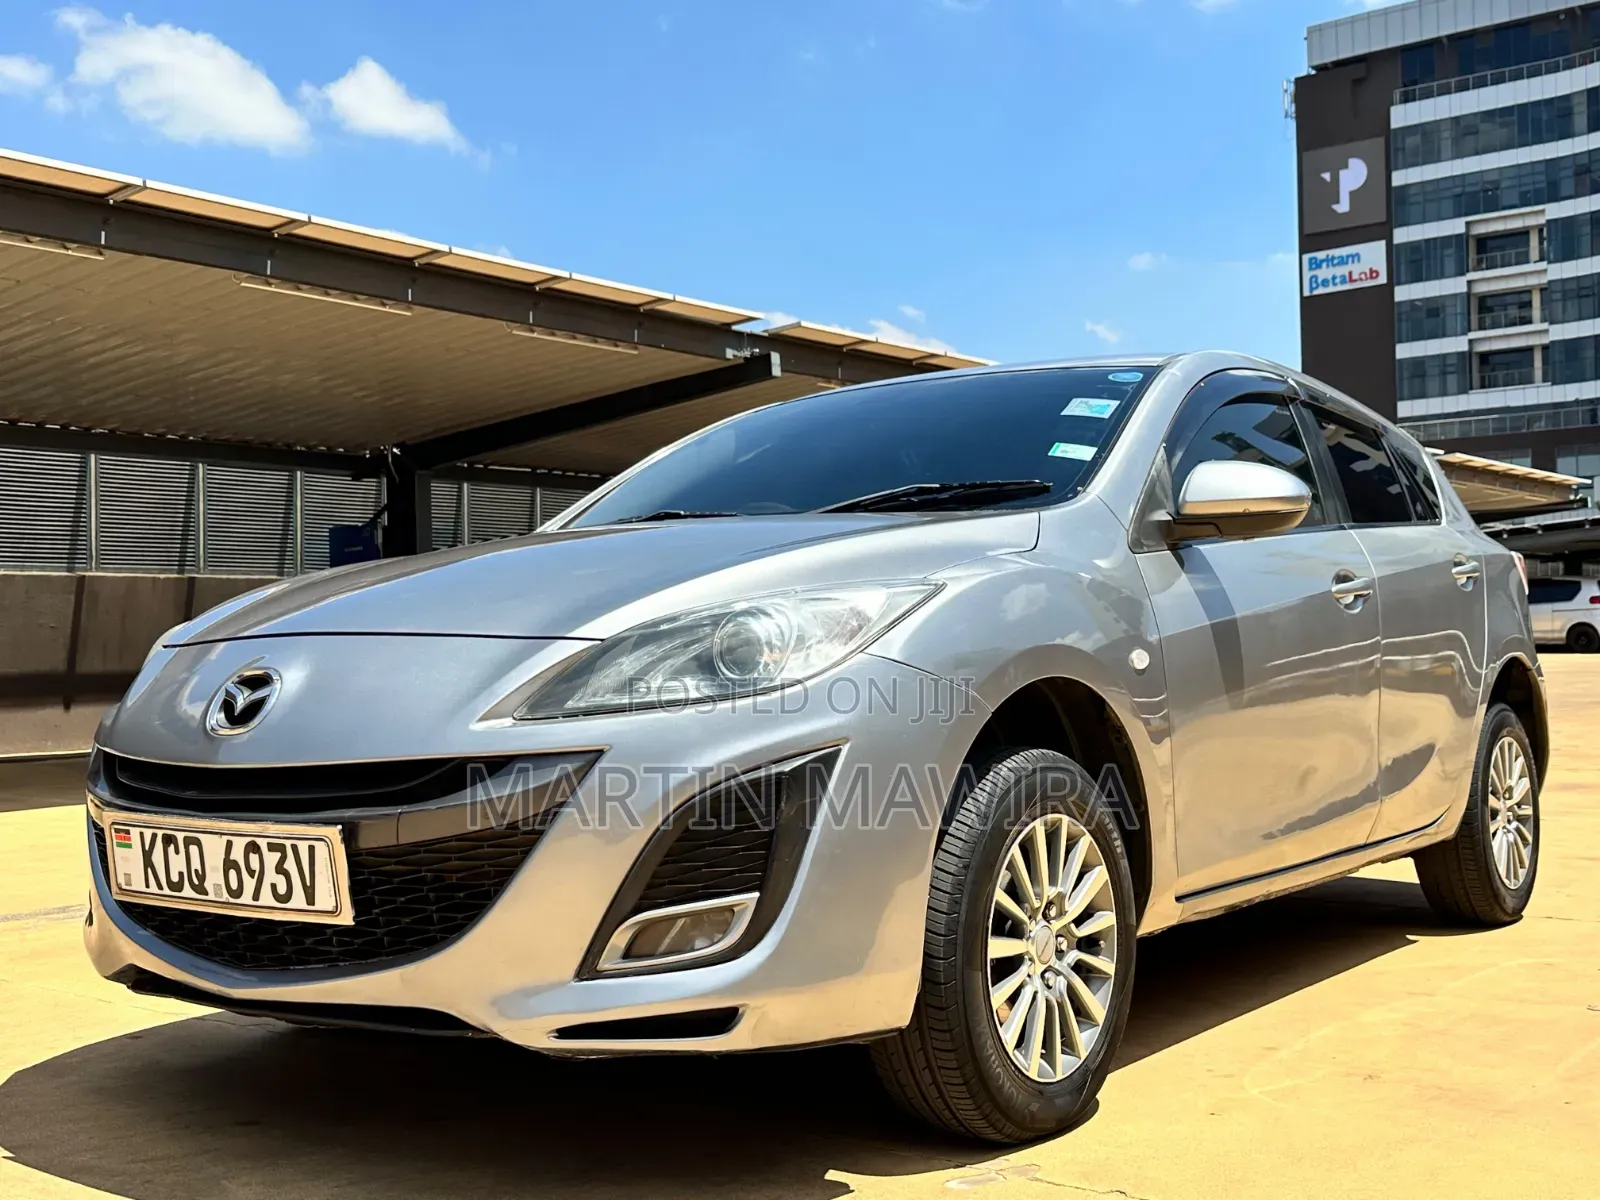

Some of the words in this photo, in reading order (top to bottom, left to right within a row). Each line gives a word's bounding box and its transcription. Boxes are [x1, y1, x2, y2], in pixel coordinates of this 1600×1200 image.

[1308, 252, 1361, 271] Britam
[139, 831, 209, 896] KCQ
[222, 839, 316, 907] 693V
[974, 1018, 1022, 1109] YOKOHAM
